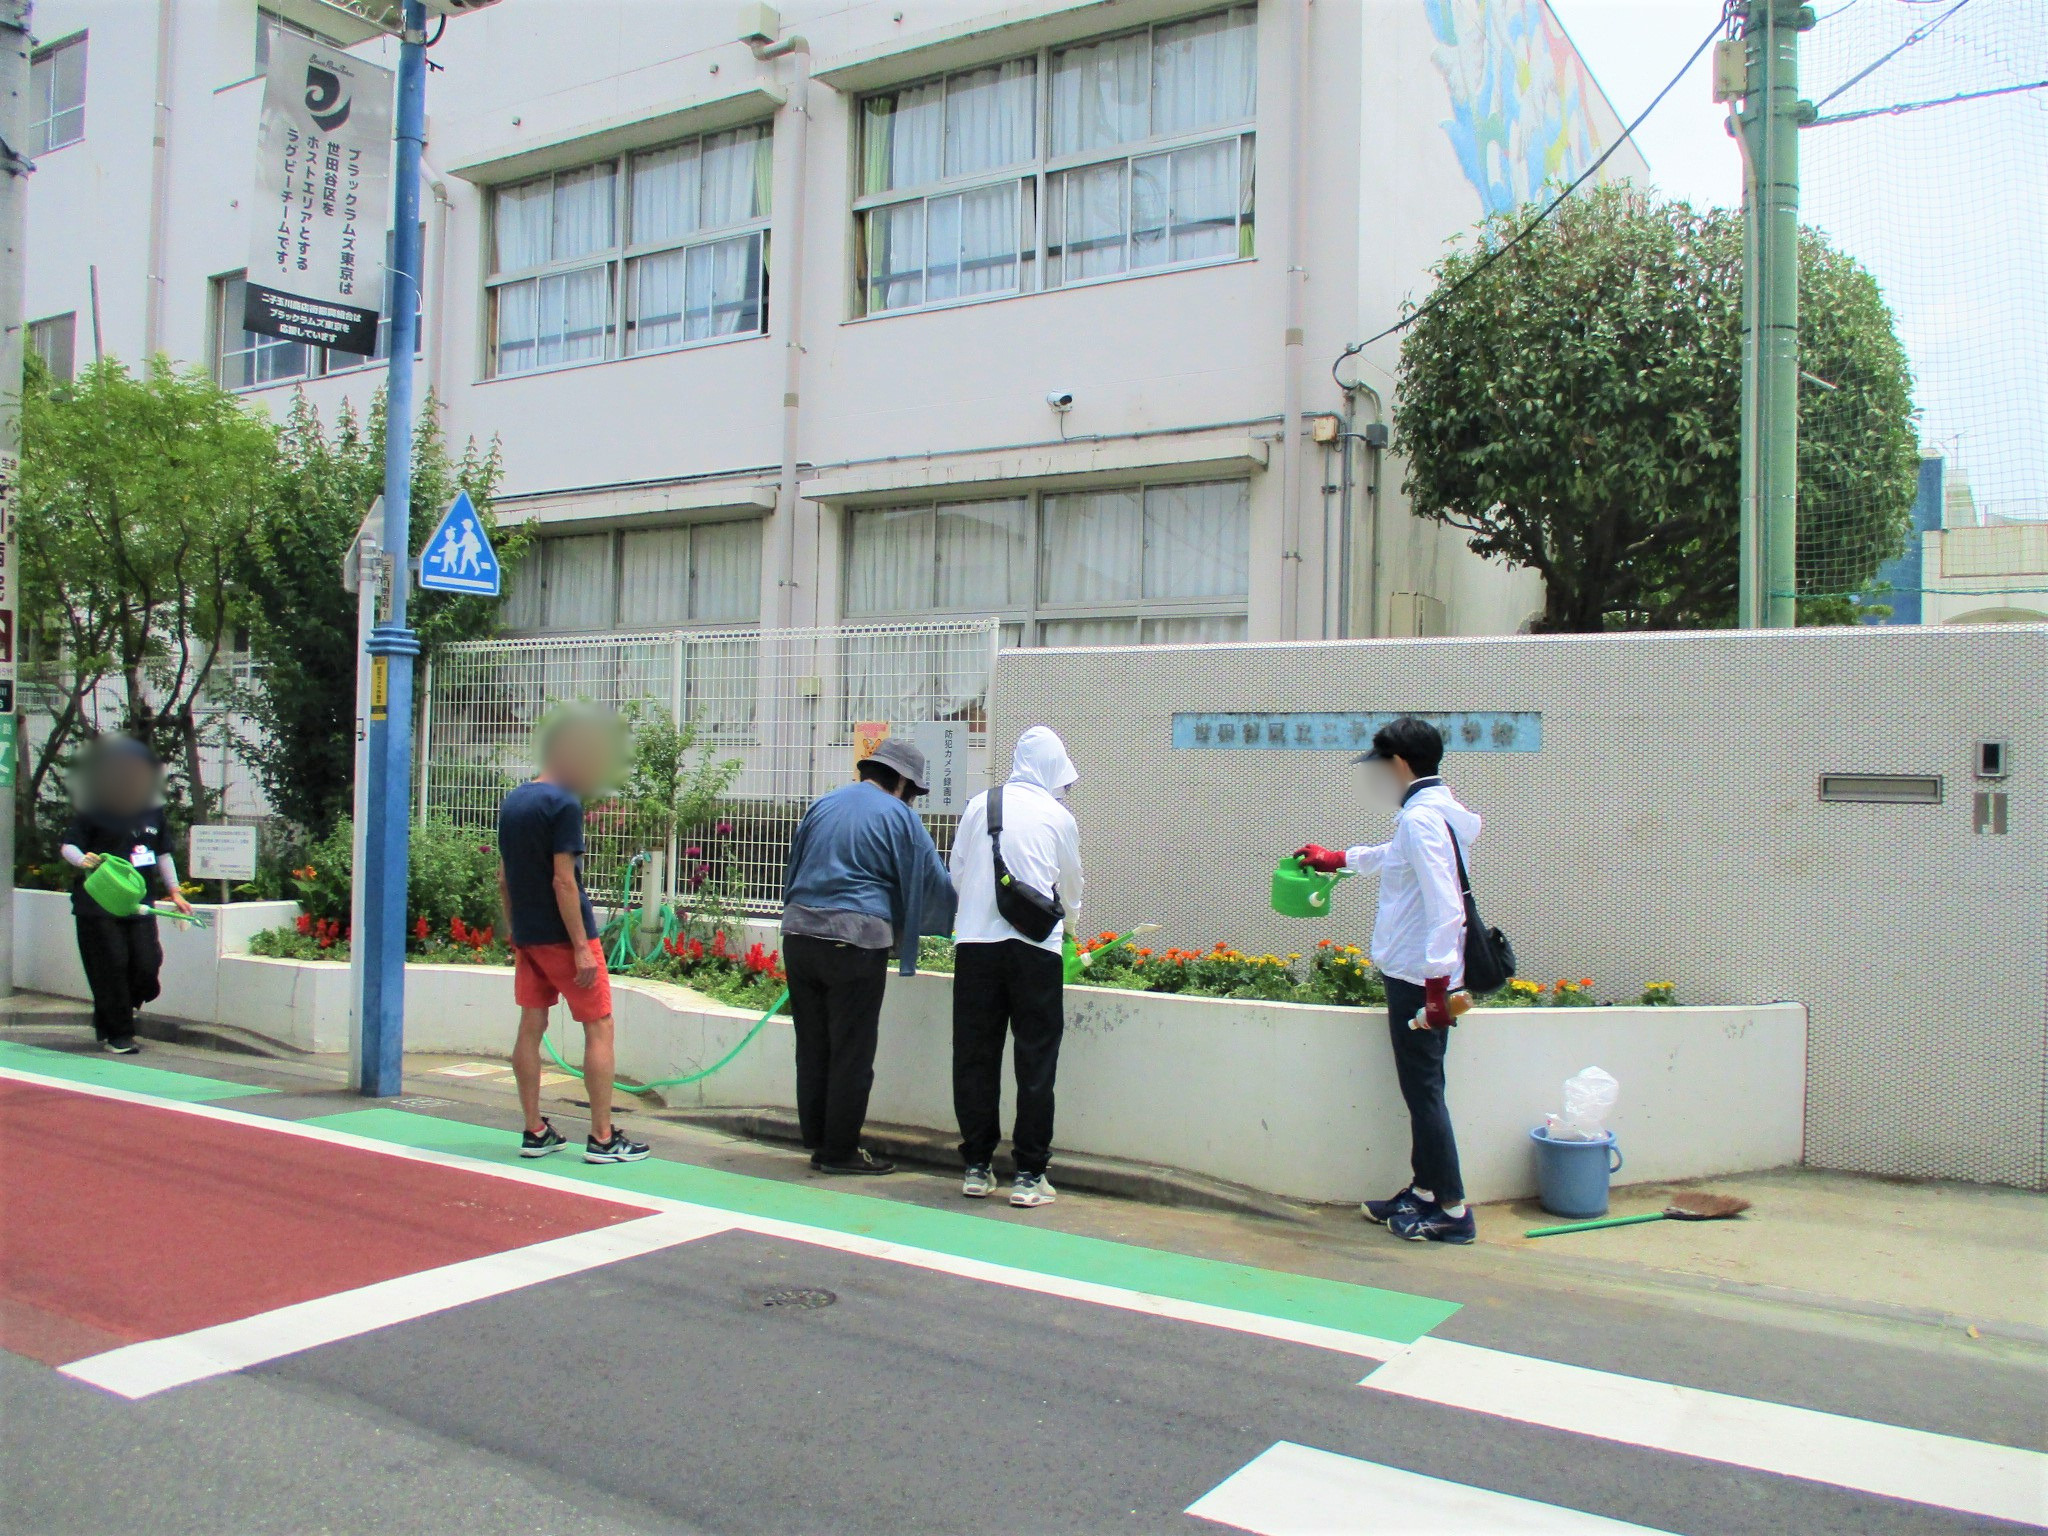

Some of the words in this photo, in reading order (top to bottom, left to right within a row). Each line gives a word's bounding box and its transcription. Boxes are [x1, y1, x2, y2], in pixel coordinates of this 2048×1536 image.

[276, 128, 299, 273] ラグビーチームです。
[296, 136, 320, 271] ホストエリアとする
[322, 141, 341, 217] 世田谷区を
[339, 149, 362, 295] ブラックラムズ東京は
[943, 729, 953, 806] 防犯カメラ録画中
